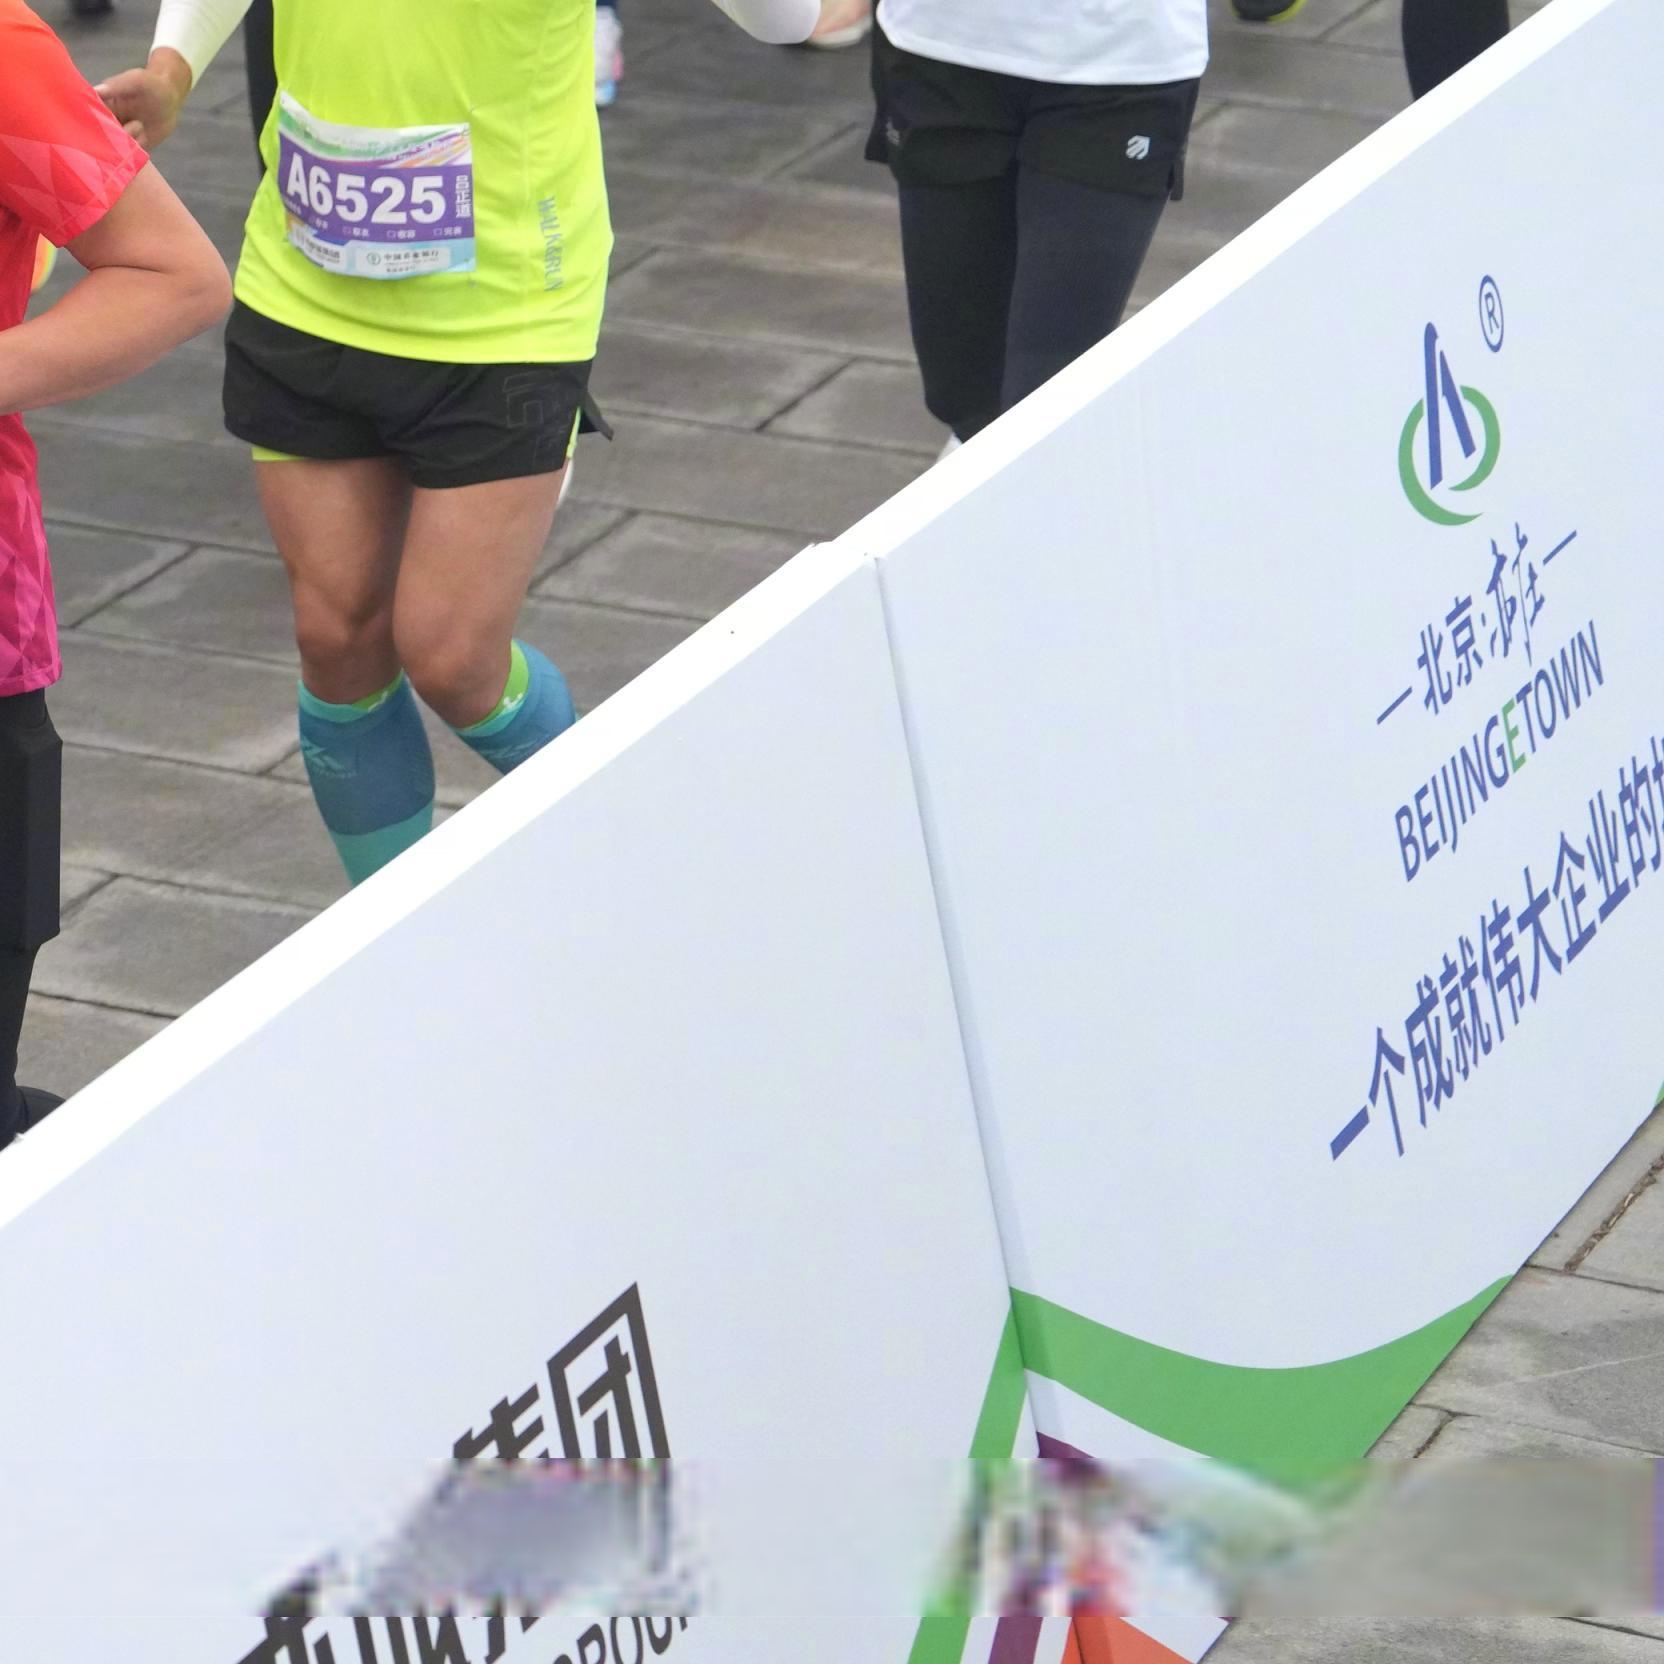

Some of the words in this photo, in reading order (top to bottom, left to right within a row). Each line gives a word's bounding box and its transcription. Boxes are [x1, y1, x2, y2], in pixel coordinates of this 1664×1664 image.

[286, 151, 446, 225] A6525
[455, 174, 473, 219] 吕正道
[1393, 619, 1605, 883] BEIJINGETOWN
